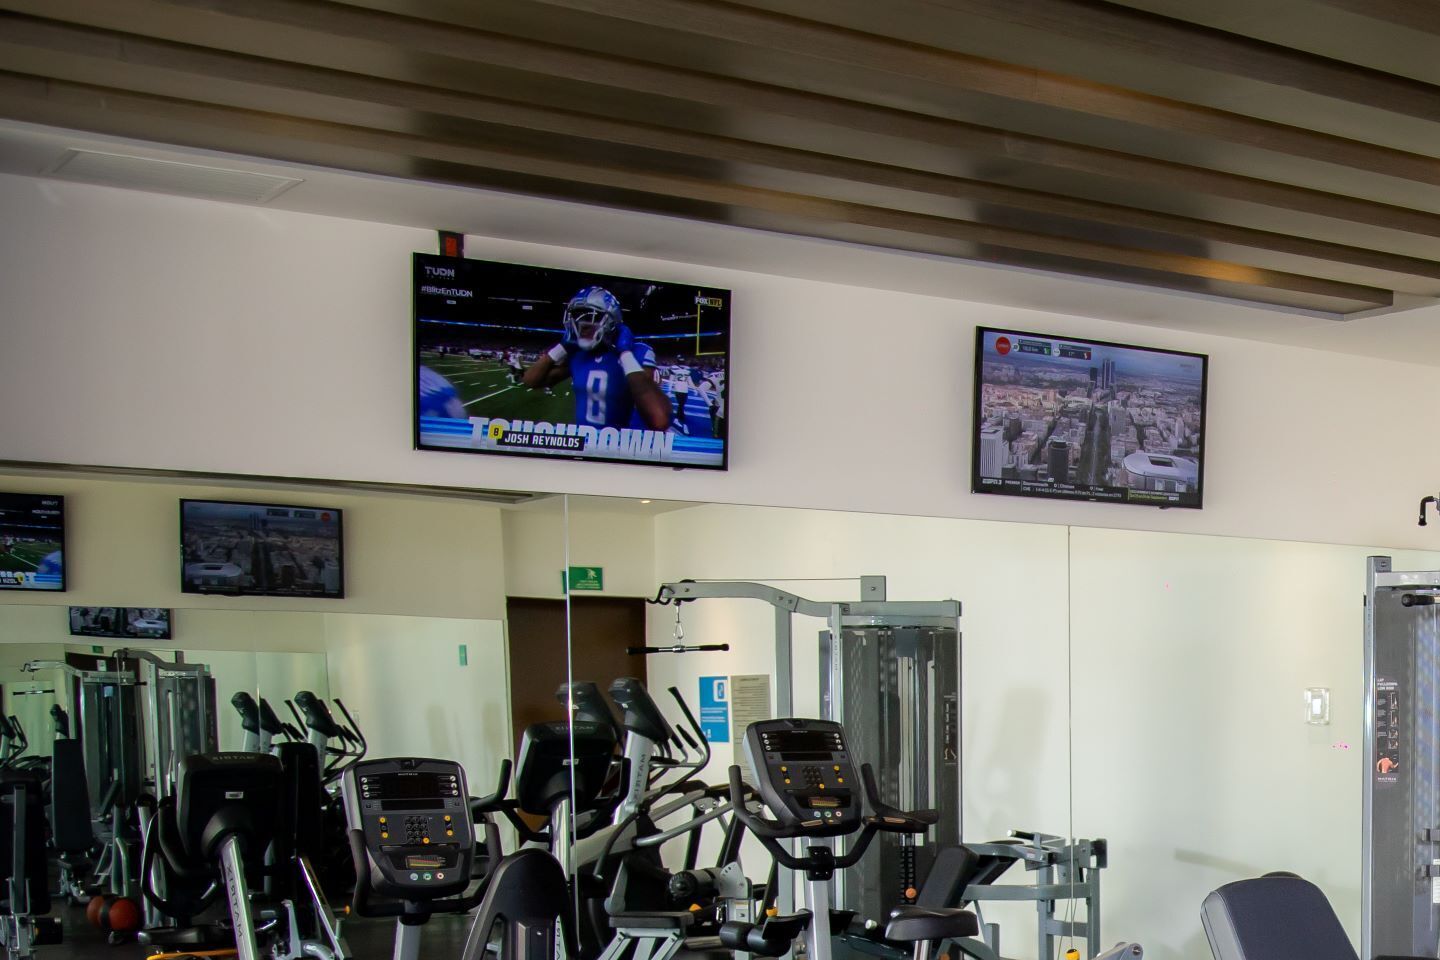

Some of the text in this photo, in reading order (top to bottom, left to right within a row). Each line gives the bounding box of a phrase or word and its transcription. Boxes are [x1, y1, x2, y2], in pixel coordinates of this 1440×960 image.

[424, 266, 455, 277] TUDN
[586, 369, 608, 425] 8
[504, 432, 529, 444] JOSH
[532, 434, 580, 448] REYNOLDS
